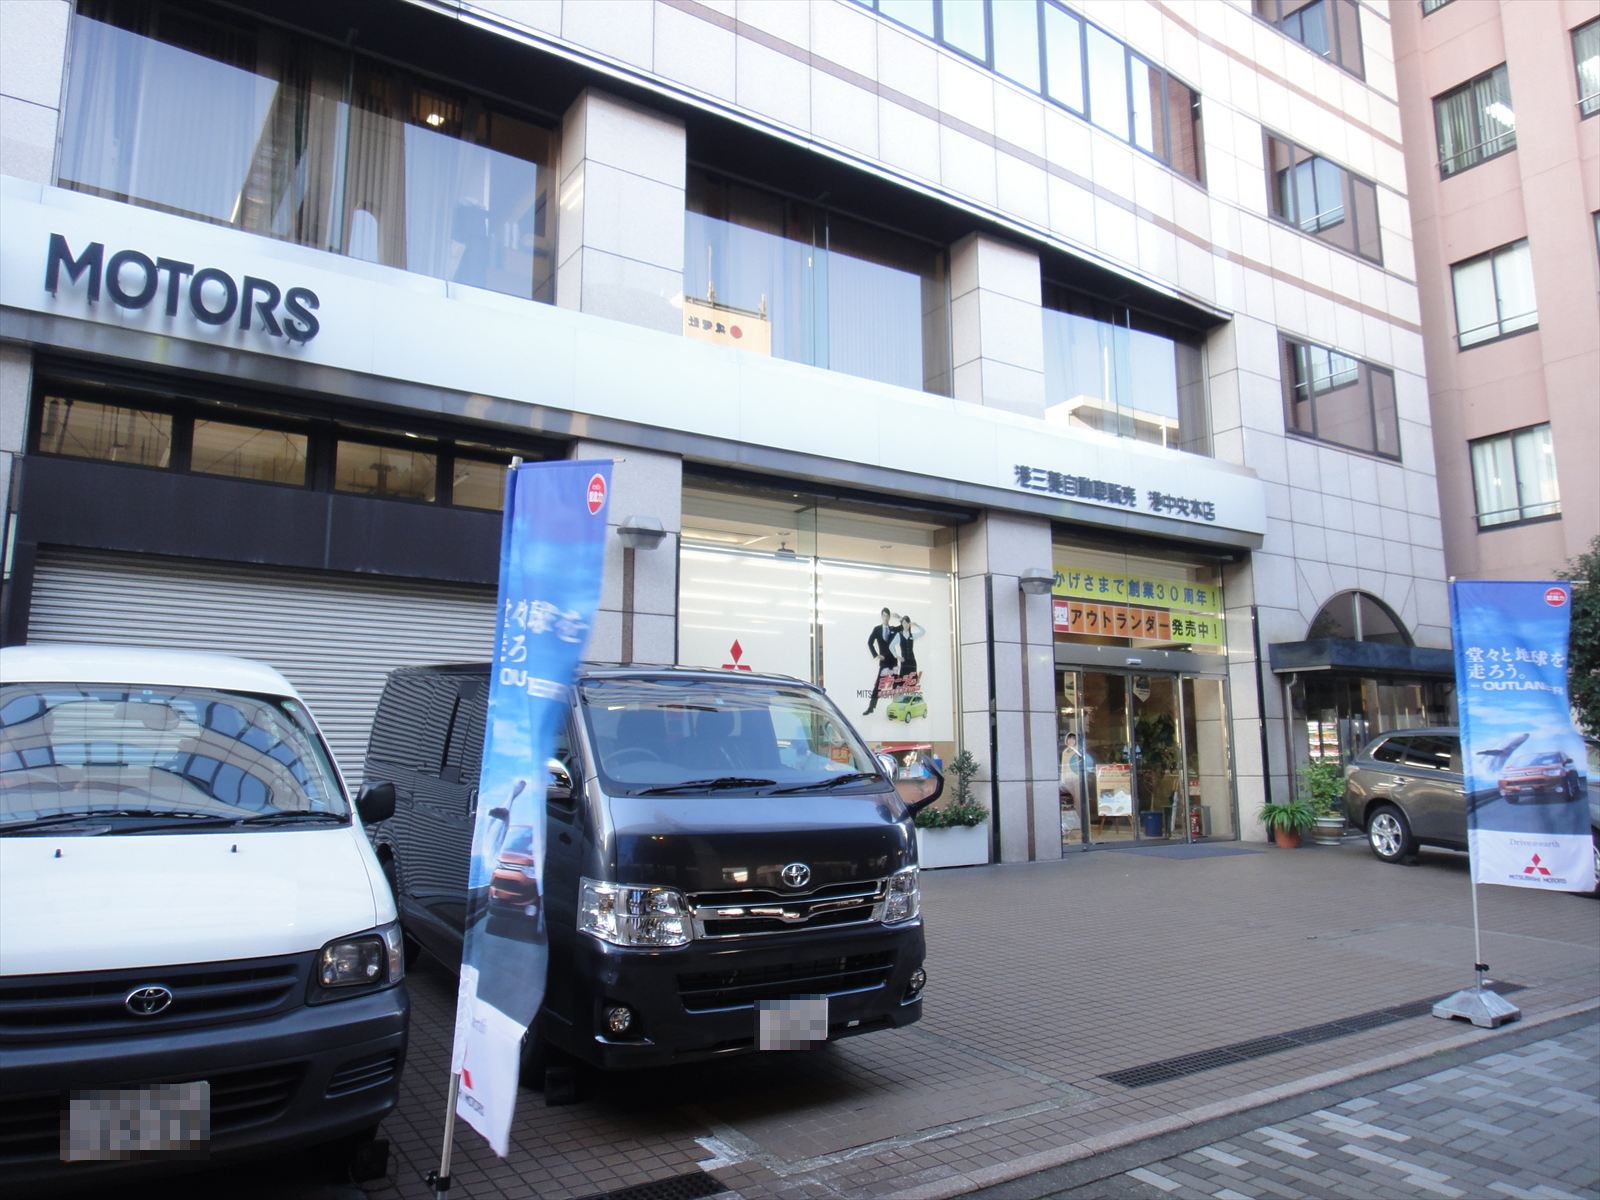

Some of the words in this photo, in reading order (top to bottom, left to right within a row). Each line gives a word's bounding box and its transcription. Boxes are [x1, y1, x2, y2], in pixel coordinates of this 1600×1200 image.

[45, 232, 321, 342] MOTORS
[1465, 646, 1566, 668] 堂々と地球を
[1467, 663, 1527, 680] 走ろう。
